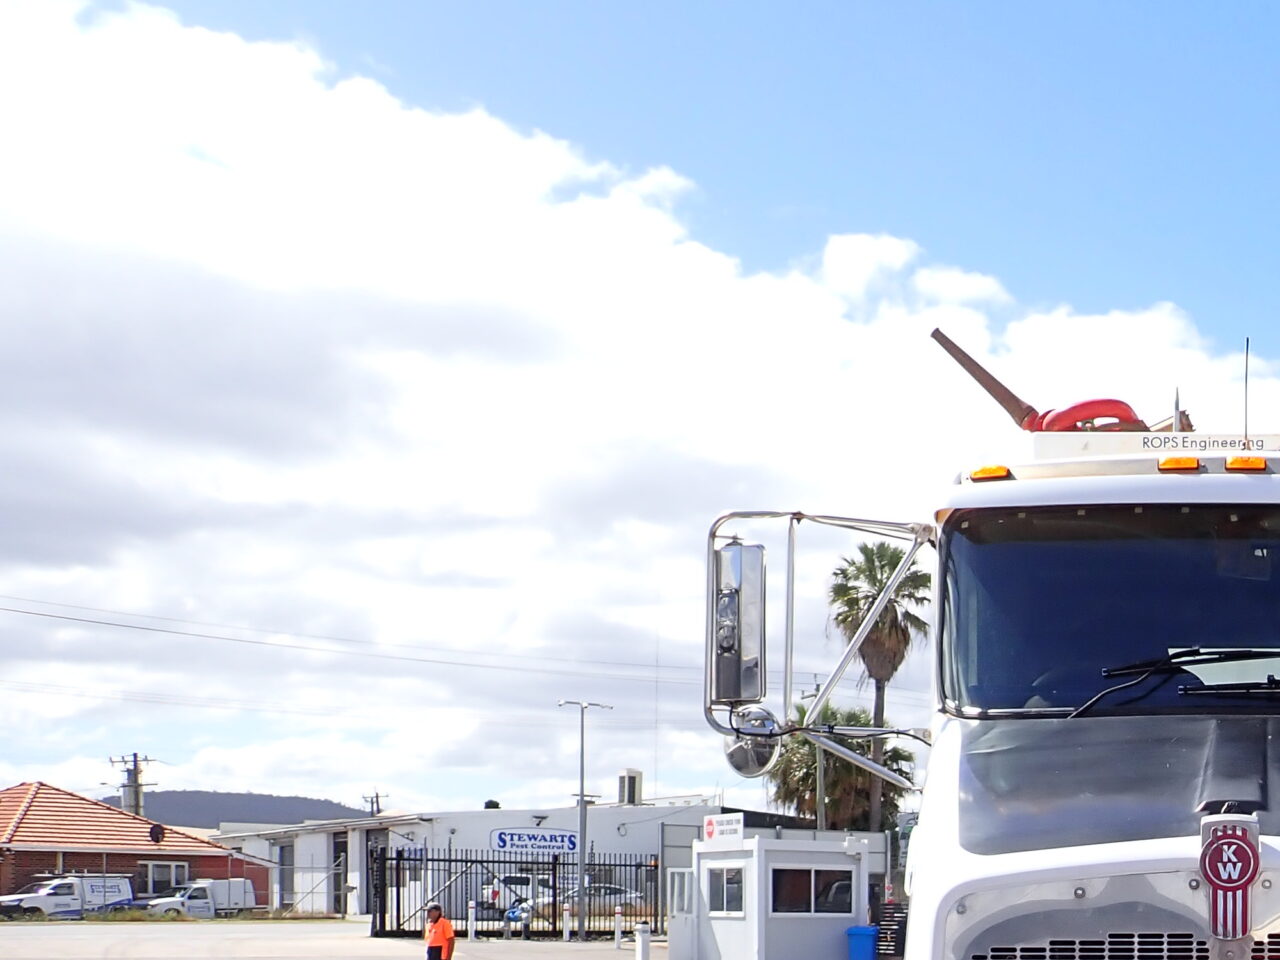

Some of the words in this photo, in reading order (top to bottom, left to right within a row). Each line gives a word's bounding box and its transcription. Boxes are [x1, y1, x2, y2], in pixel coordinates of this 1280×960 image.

[1142, 436, 1178, 449] ROPS
[497, 831, 577, 851] STEWARTS
[1222, 844, 1239, 863] K
[1217, 862, 1242, 880] W
